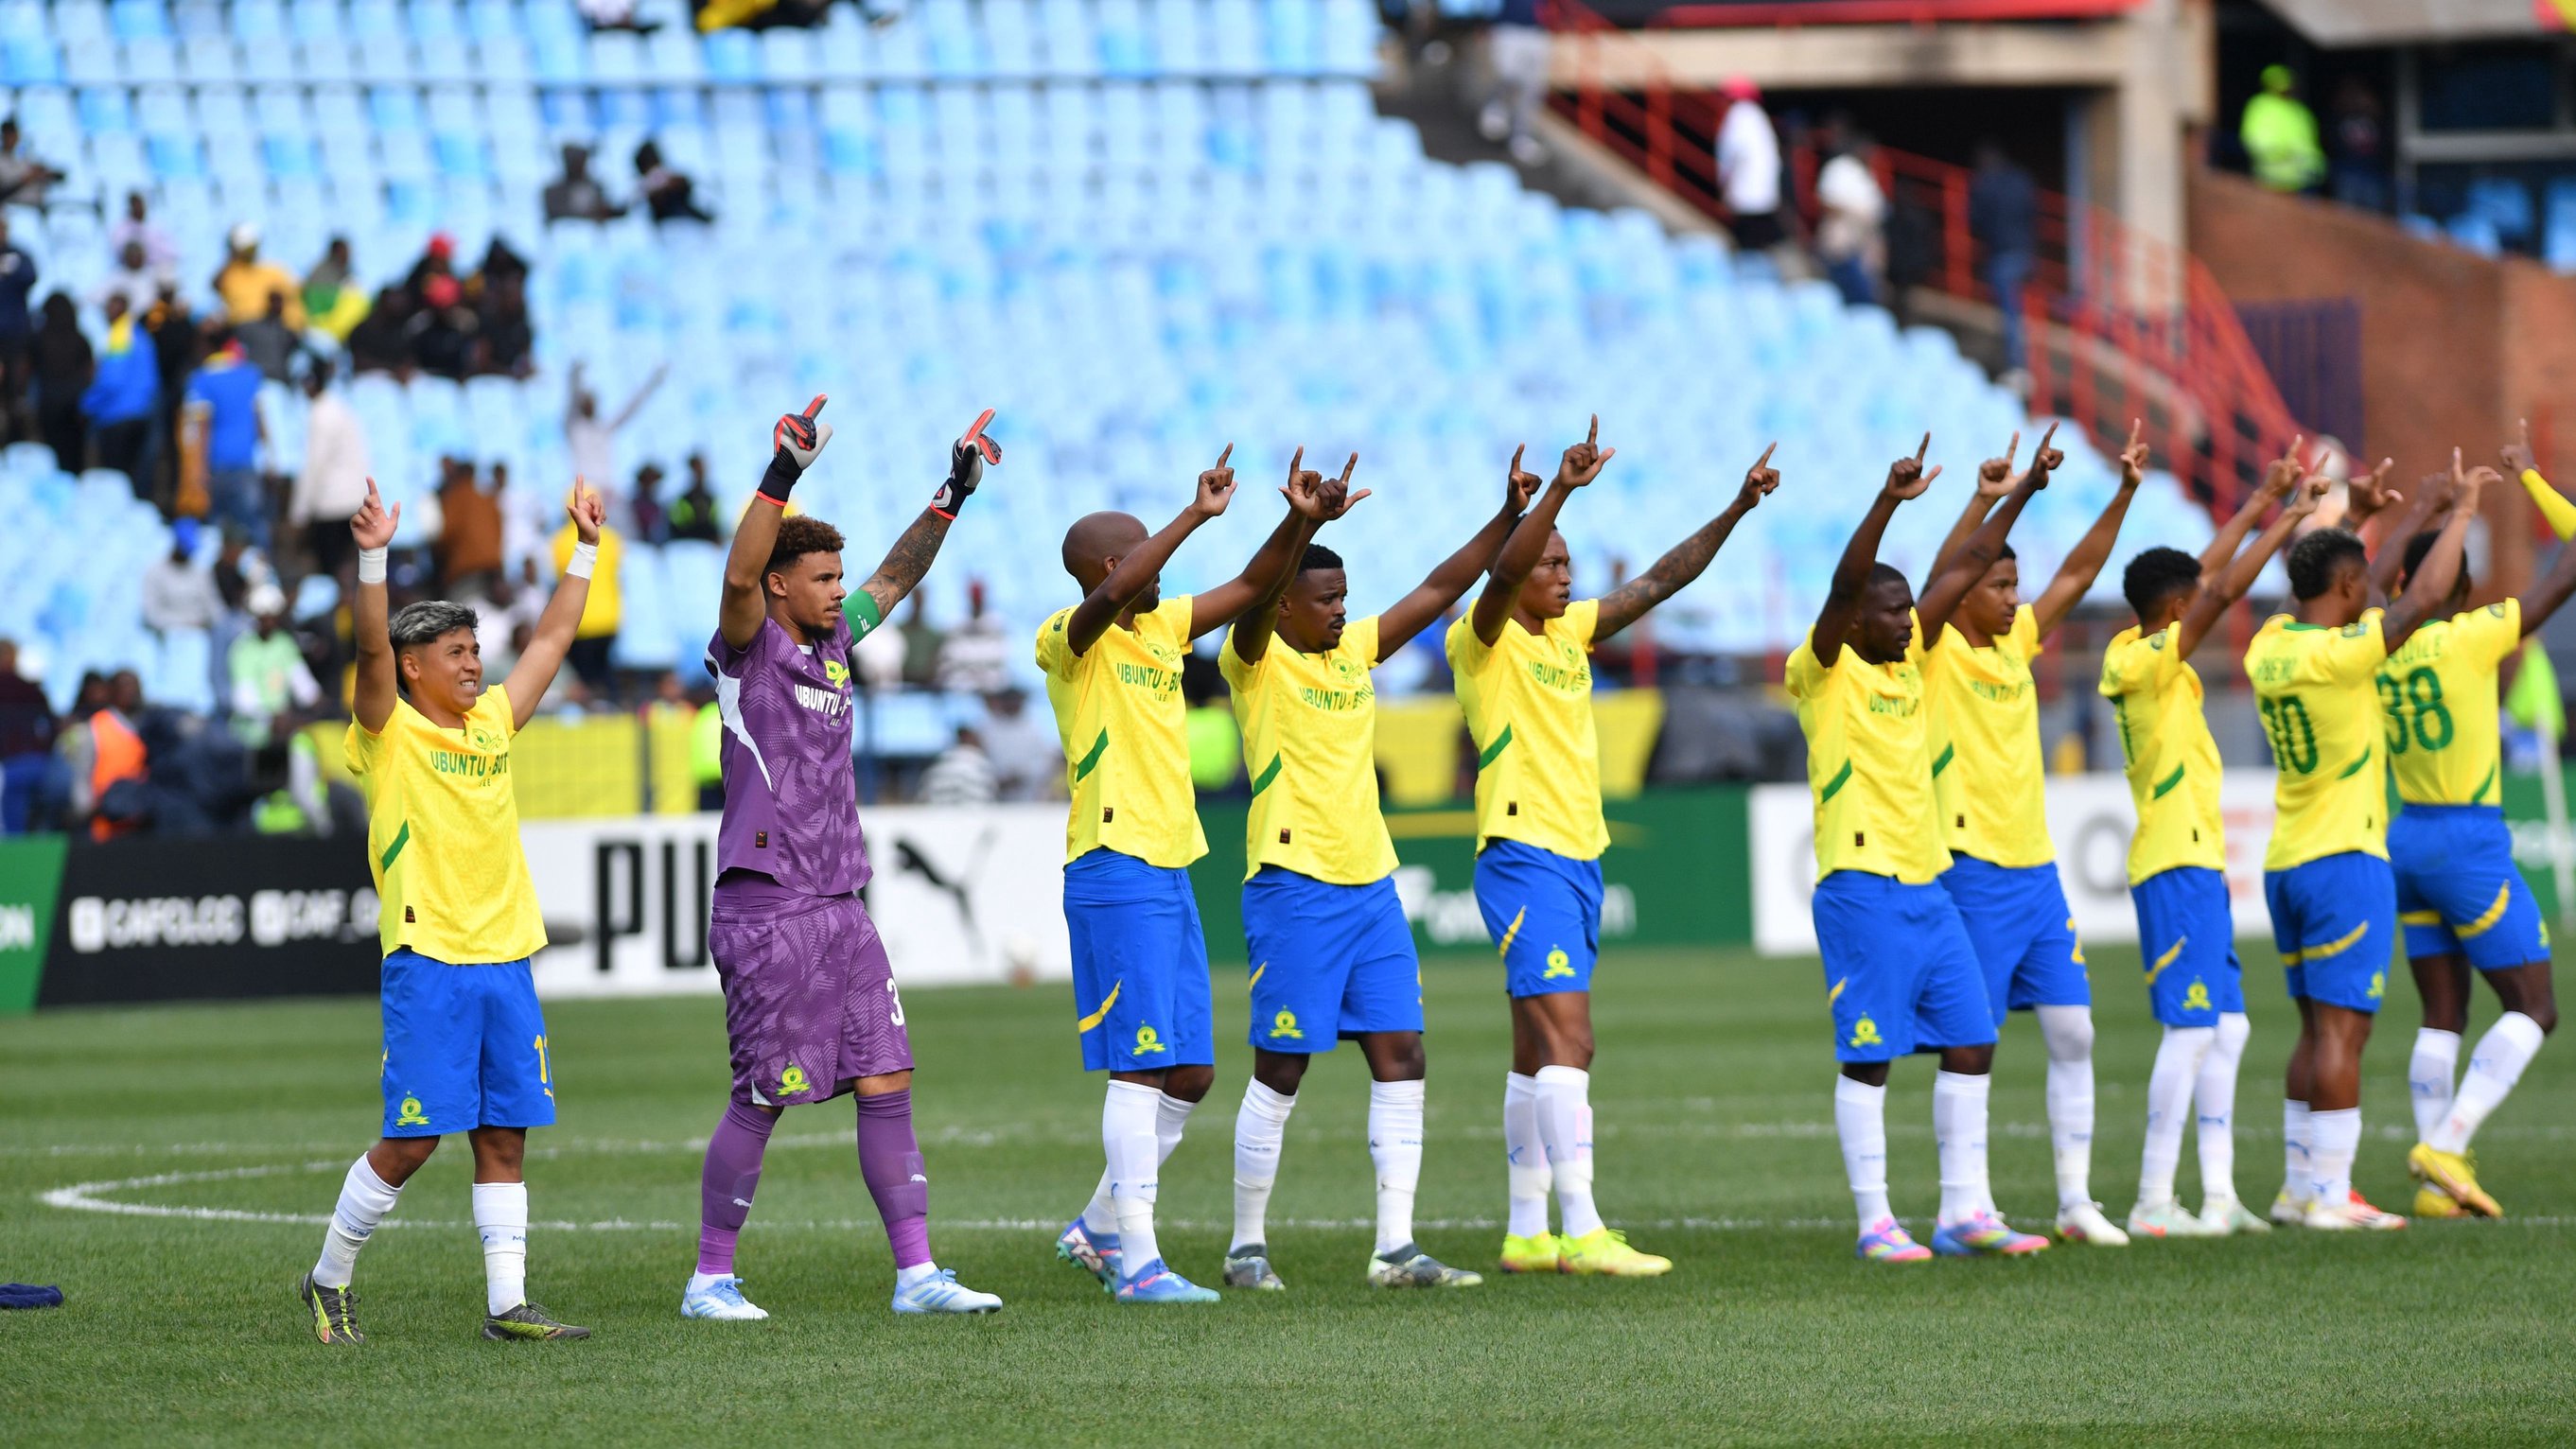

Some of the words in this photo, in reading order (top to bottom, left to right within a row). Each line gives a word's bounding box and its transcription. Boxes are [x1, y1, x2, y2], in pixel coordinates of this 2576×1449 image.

[1117, 662, 1164, 690] UBUNTU
[1528, 659, 1568, 690] UBUNTU
[795, 683, 841, 716] UBUNTU
[1299, 687, 1347, 711] UBUNTU
[2375, 665, 2455, 755] 38
[430, 749, 486, 777] UBUNTU
